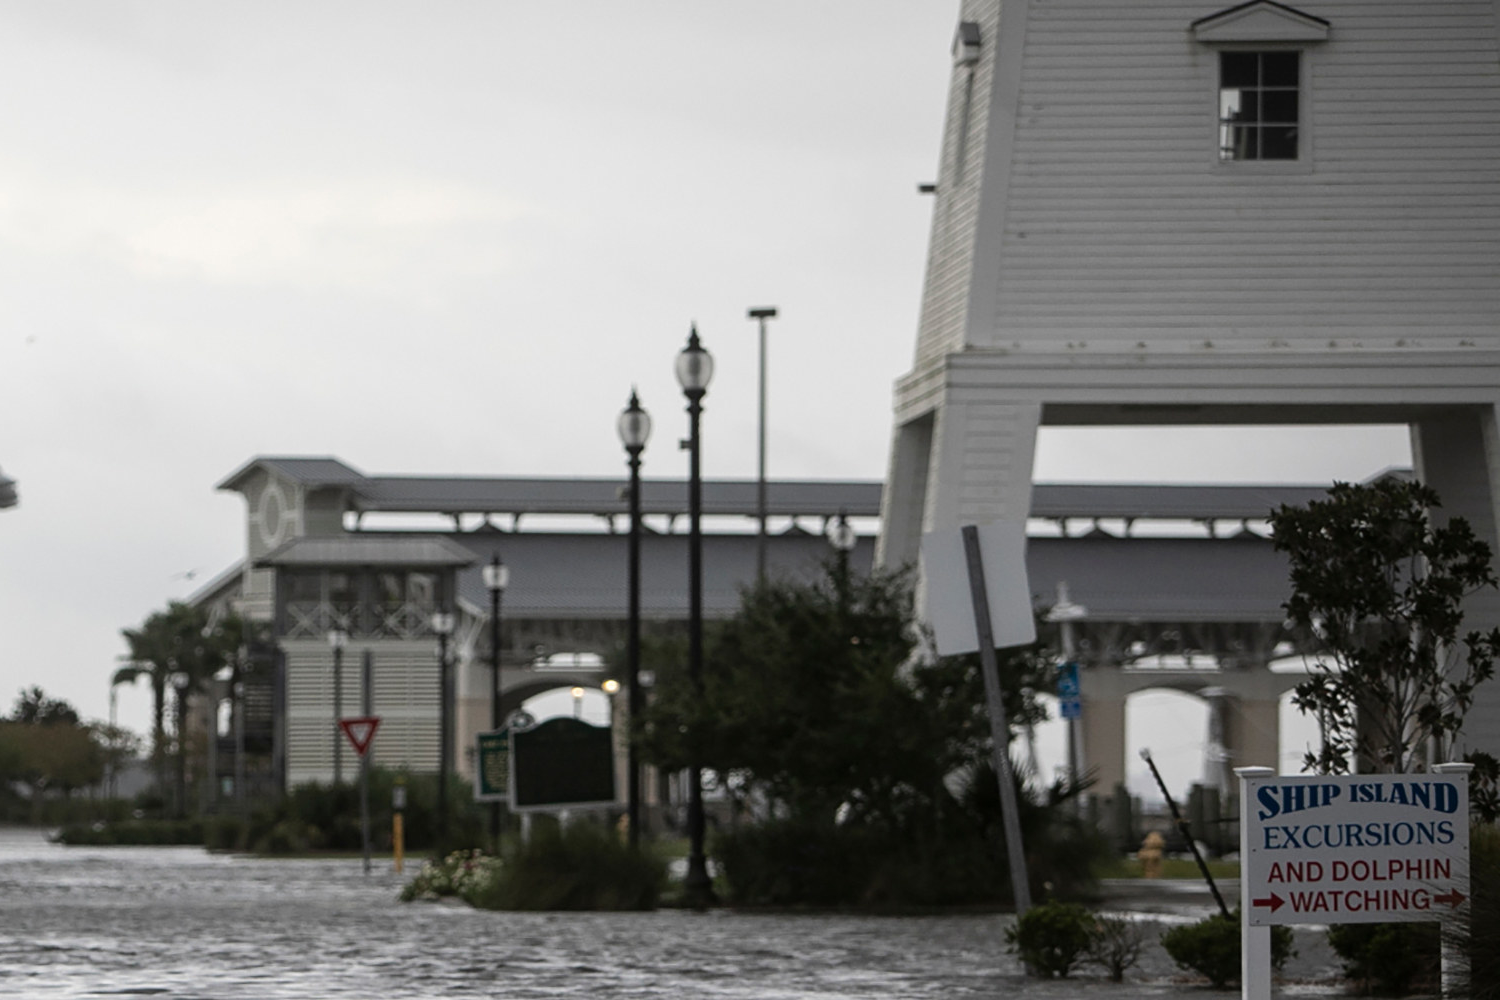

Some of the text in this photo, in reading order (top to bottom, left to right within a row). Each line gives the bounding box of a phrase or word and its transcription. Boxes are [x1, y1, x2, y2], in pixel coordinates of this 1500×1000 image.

[1257, 782, 1459, 821] SHIP ISLAND
[1264, 821, 1455, 849] EXCURSIONS
[1267, 858, 1451, 883] AND DOLPHIN
[1289, 889, 1430, 912] WATCHING
